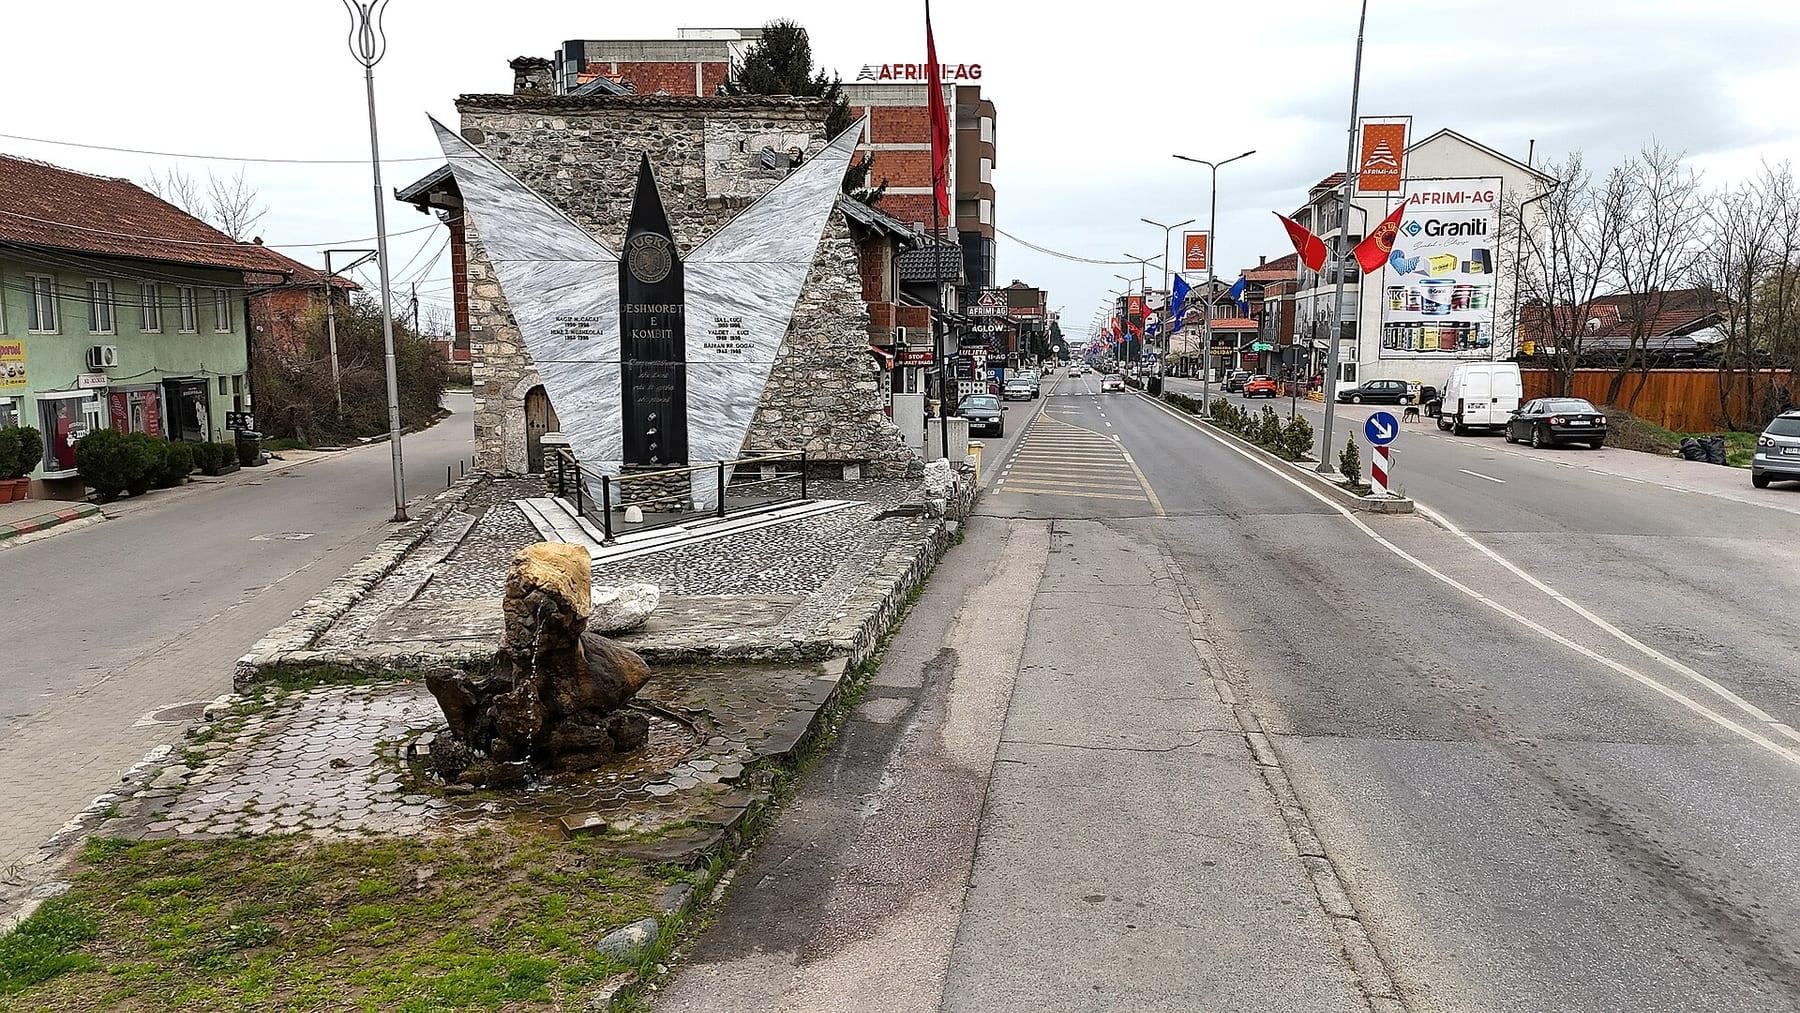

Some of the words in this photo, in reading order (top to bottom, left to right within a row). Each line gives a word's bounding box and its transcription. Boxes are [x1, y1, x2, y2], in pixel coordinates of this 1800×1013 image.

[1409, 191, 1494, 205] AFRIMI-AG
[1425, 219, 1488, 237] Graniti
[620, 303, 684, 313] DESHMORET
[650, 317, 658, 326] E
[632, 329, 672, 339] KOMBIT
